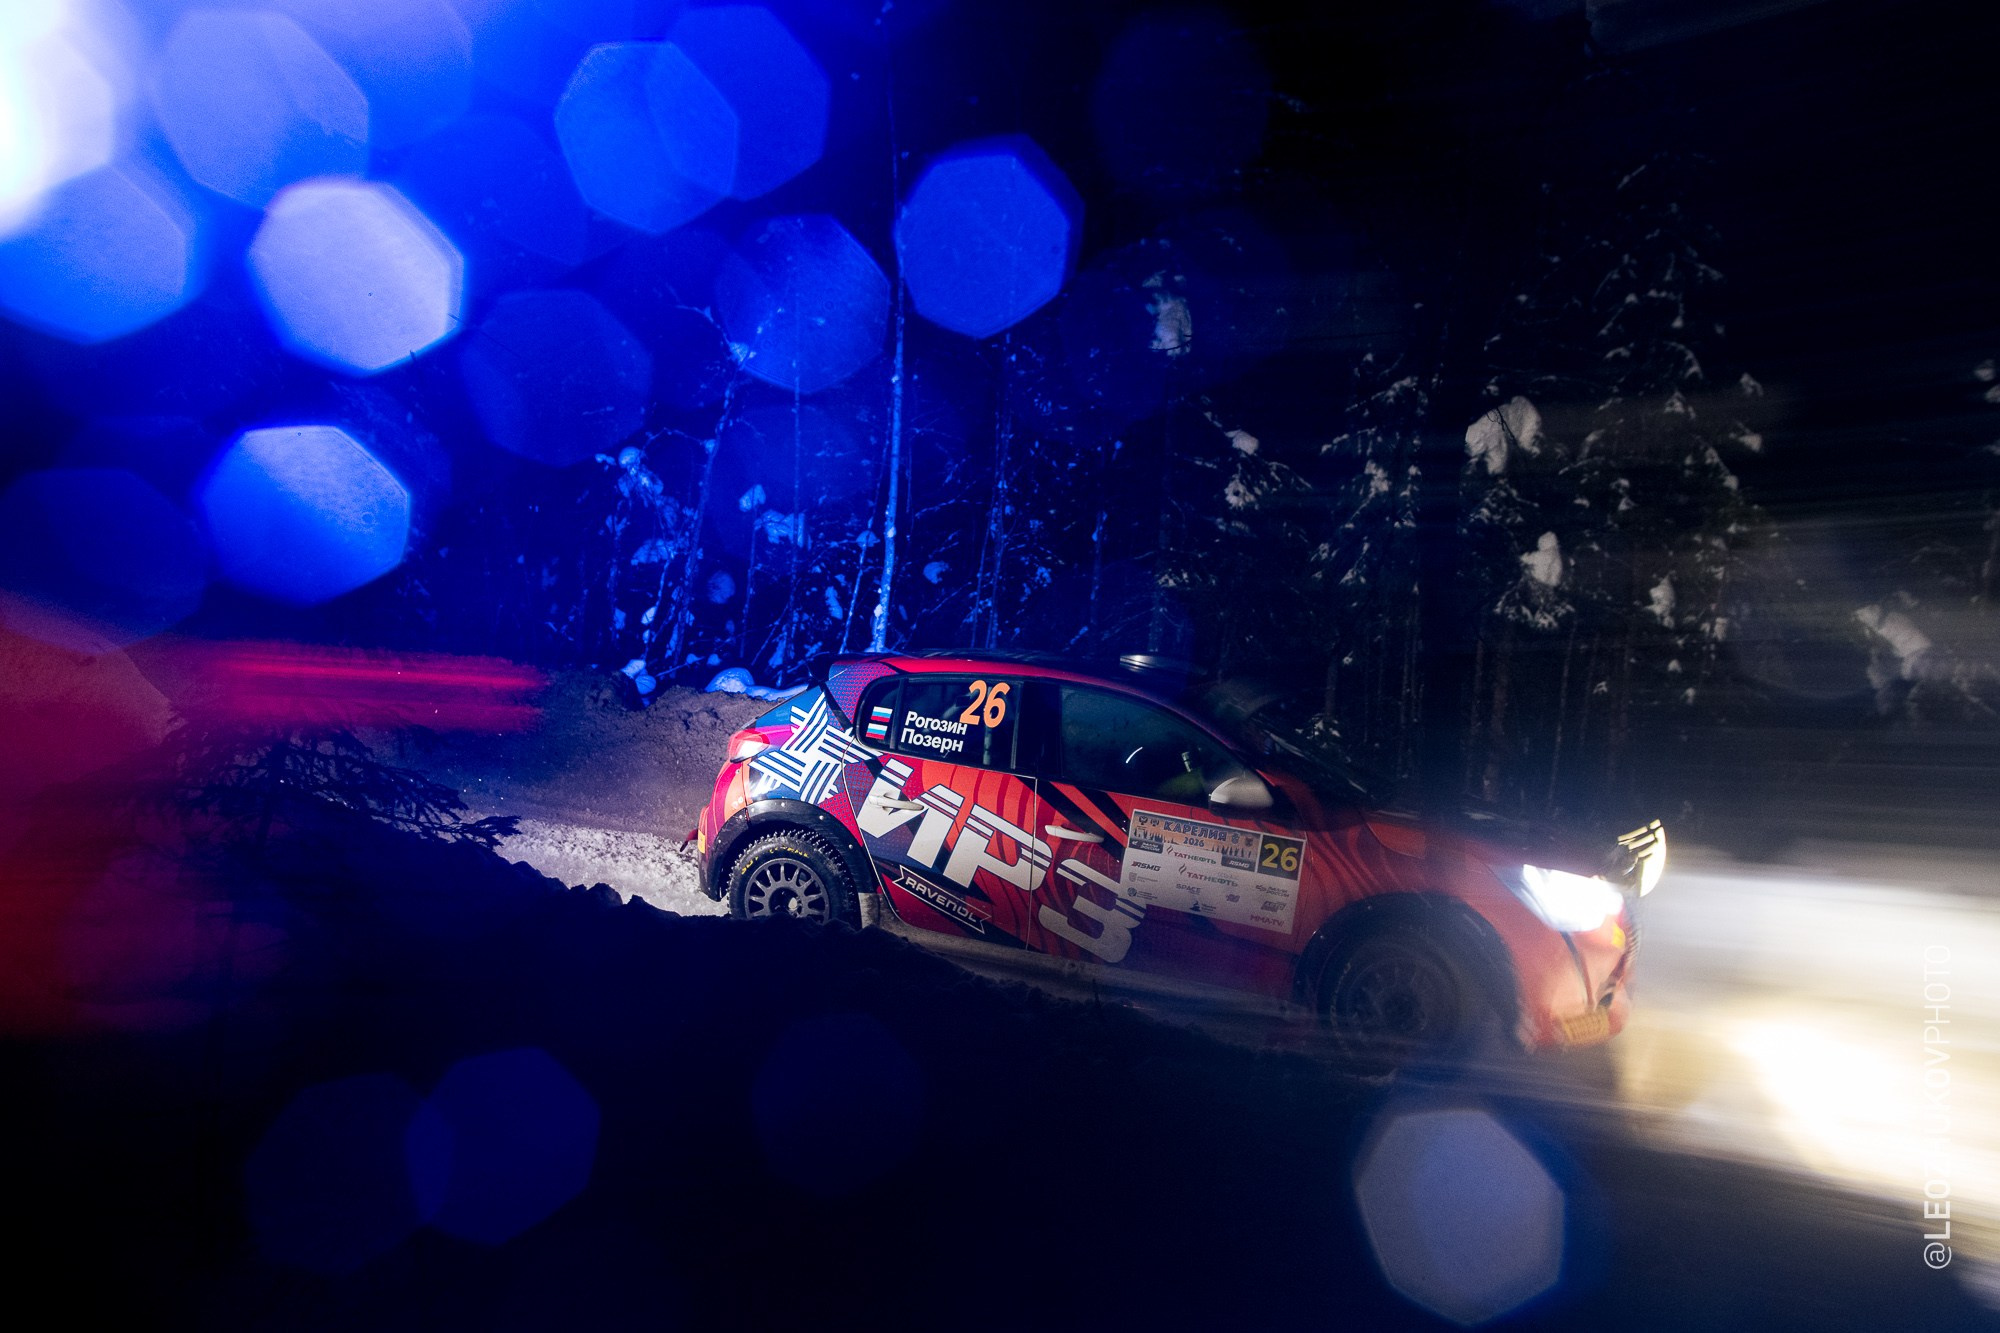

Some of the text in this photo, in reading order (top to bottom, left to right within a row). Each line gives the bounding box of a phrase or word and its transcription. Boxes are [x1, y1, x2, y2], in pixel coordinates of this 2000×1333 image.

[959, 680, 1011, 728] 26
[905, 711, 967, 735] Рогозин
[901, 728, 963, 752] Позерн
[1164, 820, 1227, 841] КАРЕЛИЯ
[1183, 836, 1205, 847] 2026
[1174, 852, 1217, 865] ТАТНЕФТЬ
[1262, 843, 1298, 872] 26
[1176, 884, 1201, 893] SPACE
[1187, 872, 1238, 887] ТАТНЕФТЬ
[904, 876, 978, 923] RAVENOL
